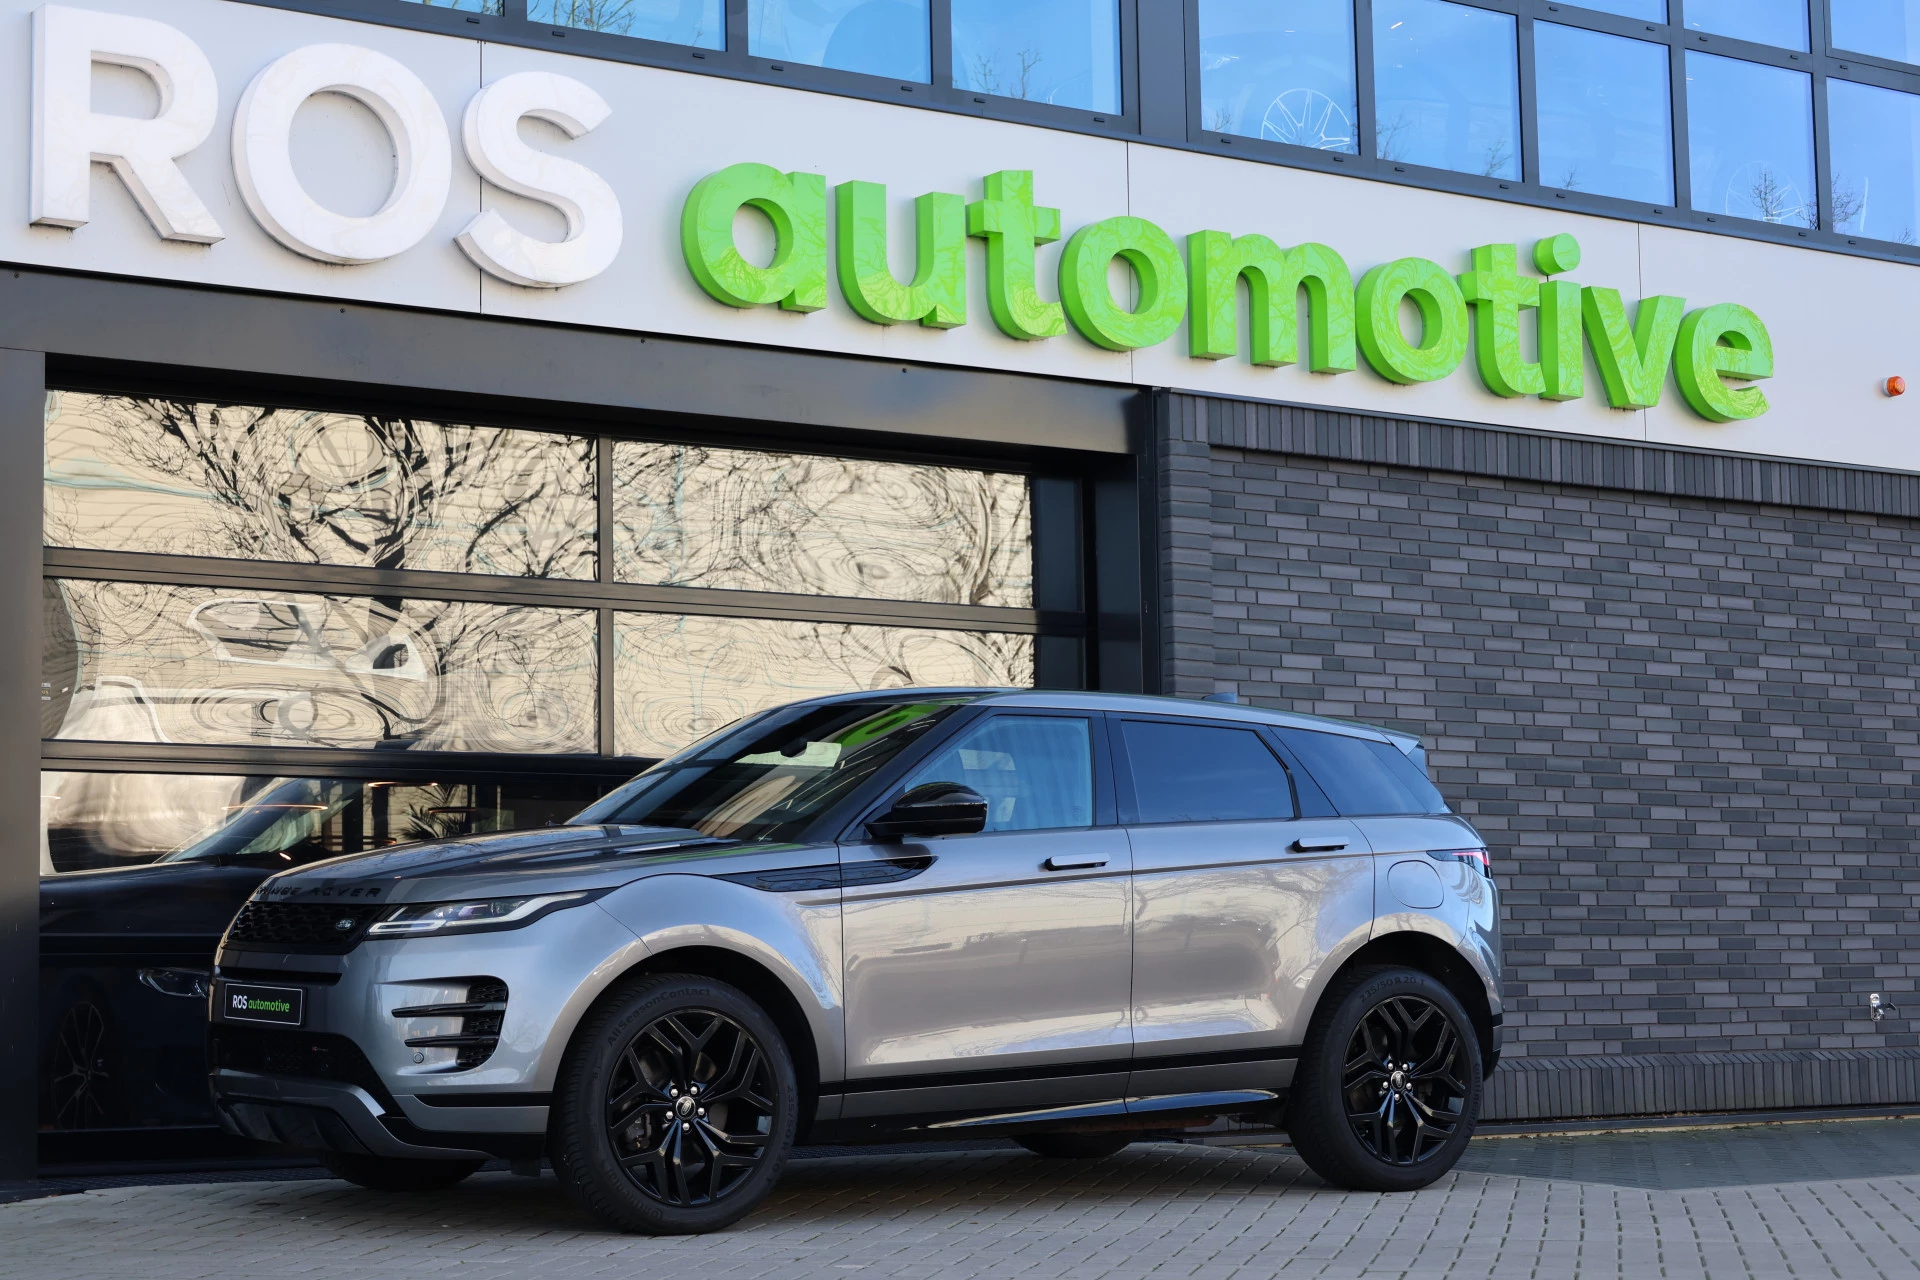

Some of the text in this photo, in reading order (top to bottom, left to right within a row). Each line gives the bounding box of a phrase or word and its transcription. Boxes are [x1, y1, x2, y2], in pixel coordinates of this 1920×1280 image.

[30, 4, 1774, 423] ROS automotive
[232, 994, 290, 1013] ROS automotive
[607, 987, 711, 1047] AllSeasonContact
